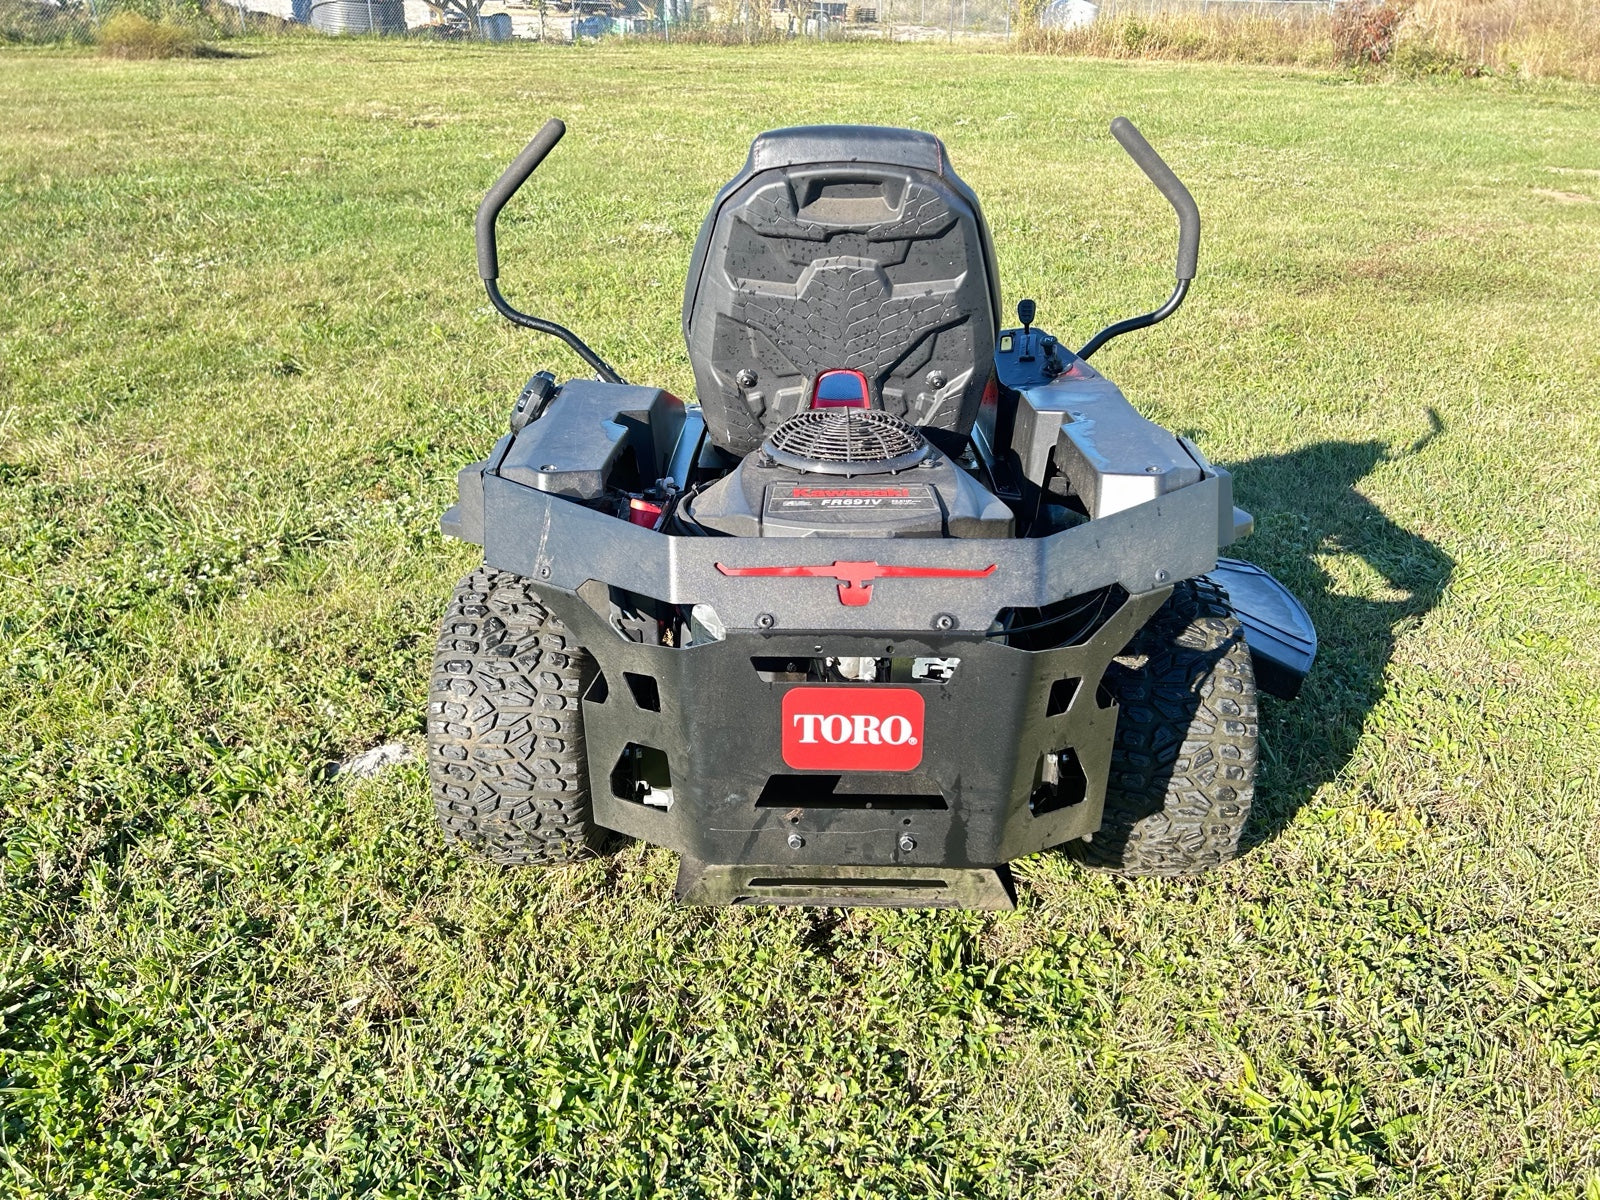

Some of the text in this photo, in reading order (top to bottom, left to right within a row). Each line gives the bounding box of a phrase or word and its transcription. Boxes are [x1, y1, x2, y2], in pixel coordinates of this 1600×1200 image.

[792, 487, 909, 498] Kawasaki
[821, 498, 882, 506] FR691V
[793, 714, 913, 746] TORO
